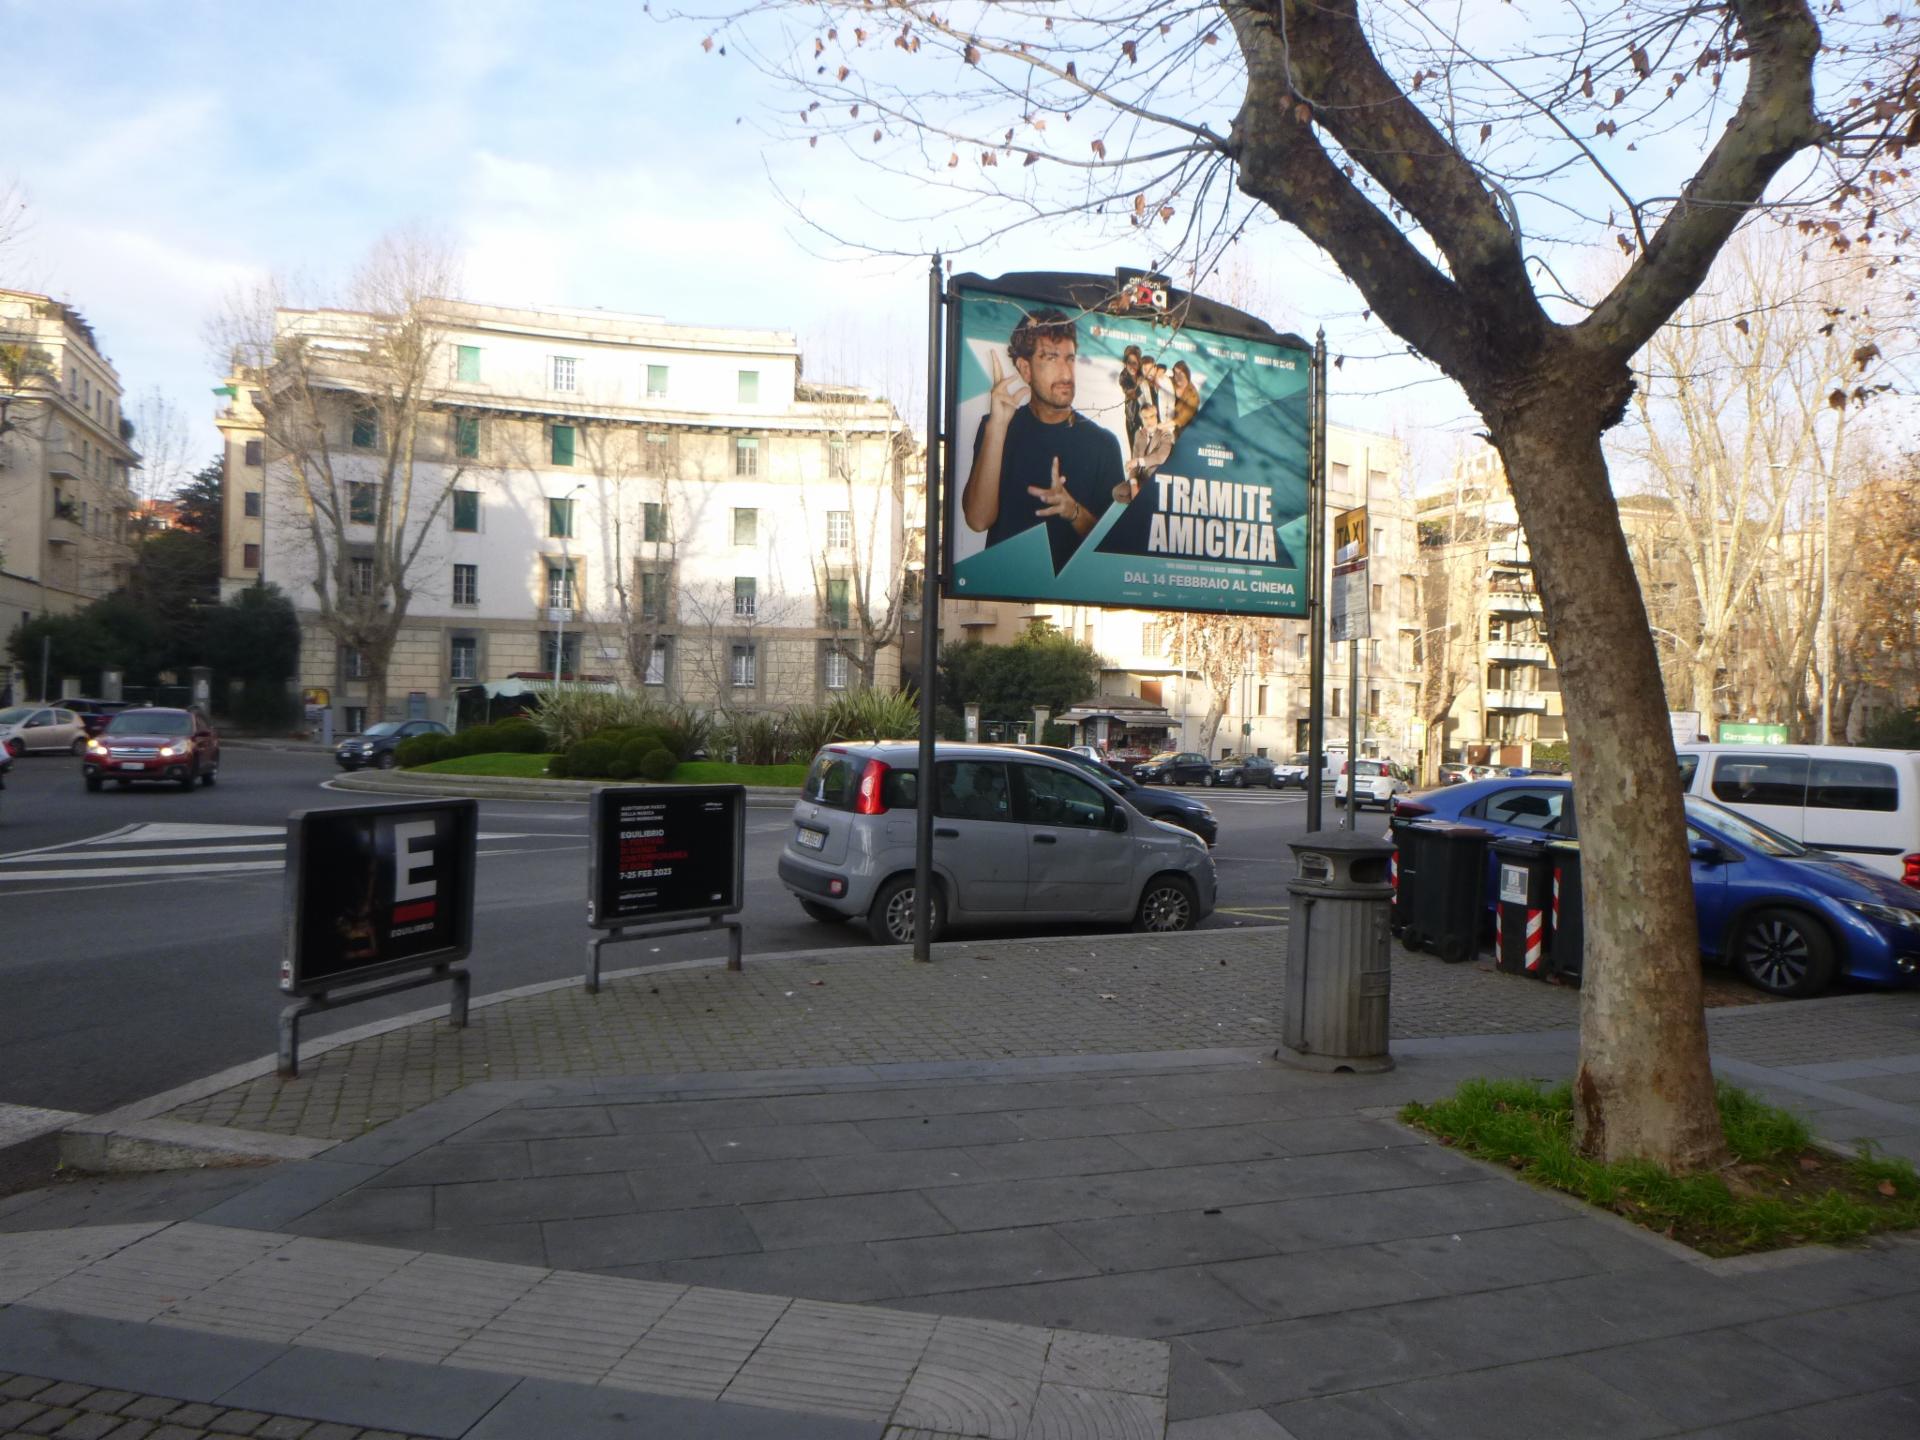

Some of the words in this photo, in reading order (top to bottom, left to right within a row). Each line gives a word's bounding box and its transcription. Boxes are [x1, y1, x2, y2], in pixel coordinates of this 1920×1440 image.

[1155, 474, 1272, 522] TRAMITE
[1147, 513, 1277, 562] AMICIZIA
[1336, 519, 1364, 547] TAXI
[1124, 571, 1149, 584] DAL
[1152, 573, 1165, 585] 14
[1168, 575, 1230, 590] FEBBRAIO
[1232, 580, 1248, 592] AL
[1250, 581, 1296, 595] CINEMA
[621, 830, 664, 838] EQUILIBRIO
[394, 819, 437, 902] E
[620, 871, 636, 879] 7-25
[654, 868, 672, 876] 2023
